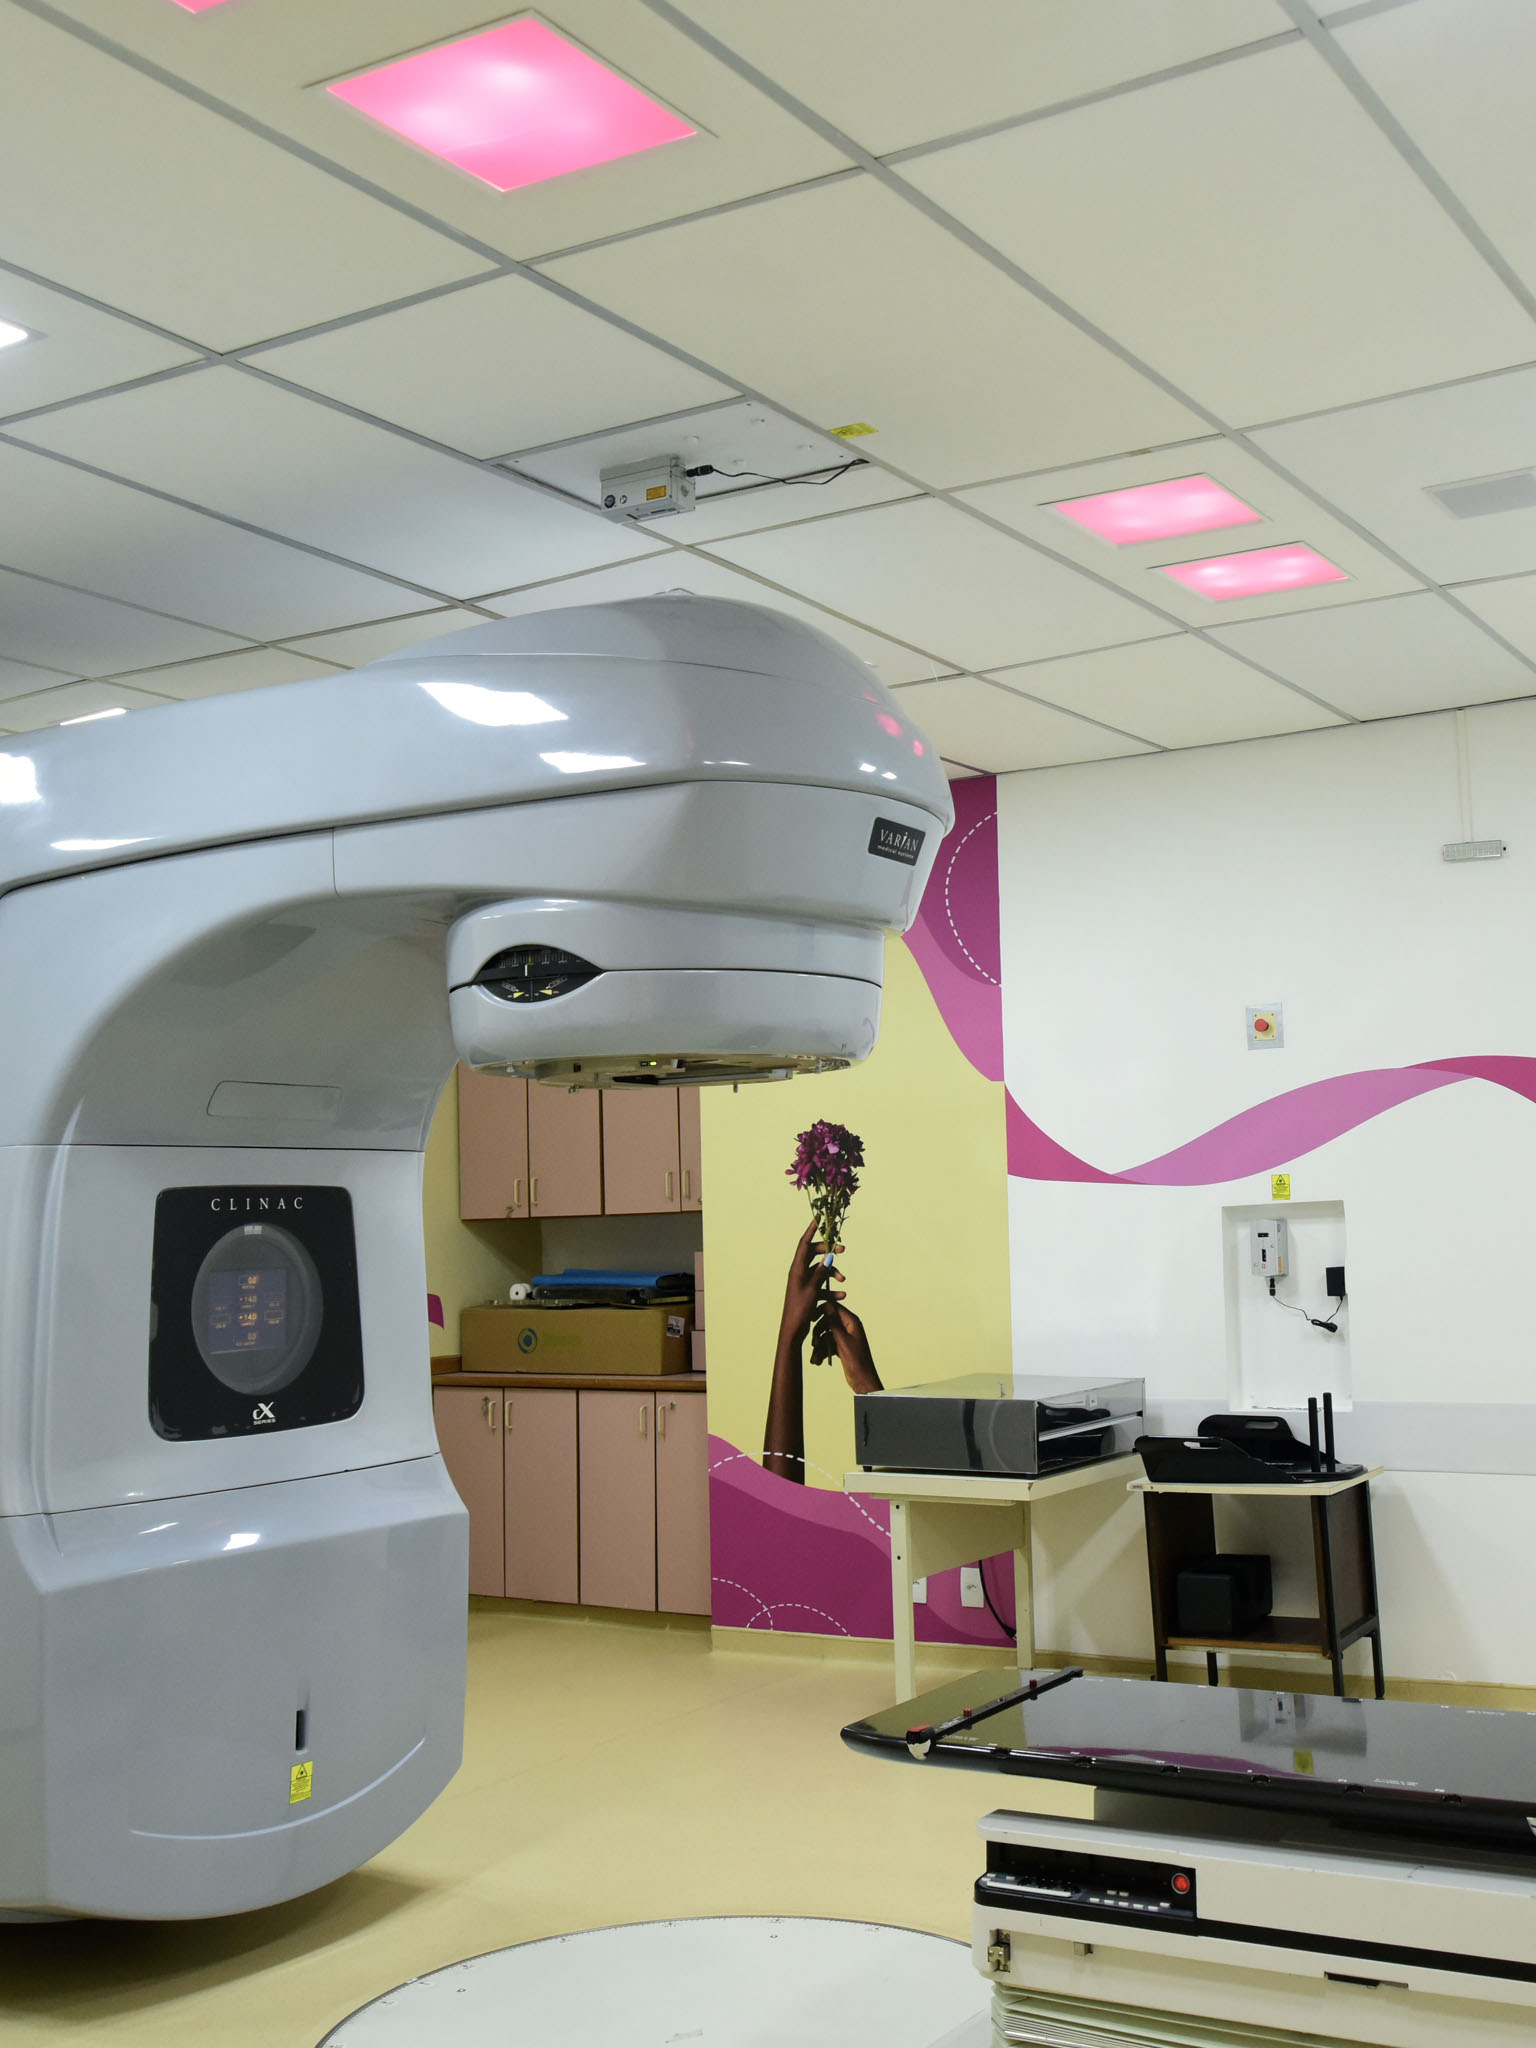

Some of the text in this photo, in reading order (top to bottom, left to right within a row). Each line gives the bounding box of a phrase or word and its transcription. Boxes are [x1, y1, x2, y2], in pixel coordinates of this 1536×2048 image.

[880, 829, 919, 851] VARIAN
[211, 1197, 303, 1211] CLINAC
[253, 1418, 277, 1426] SERIES
